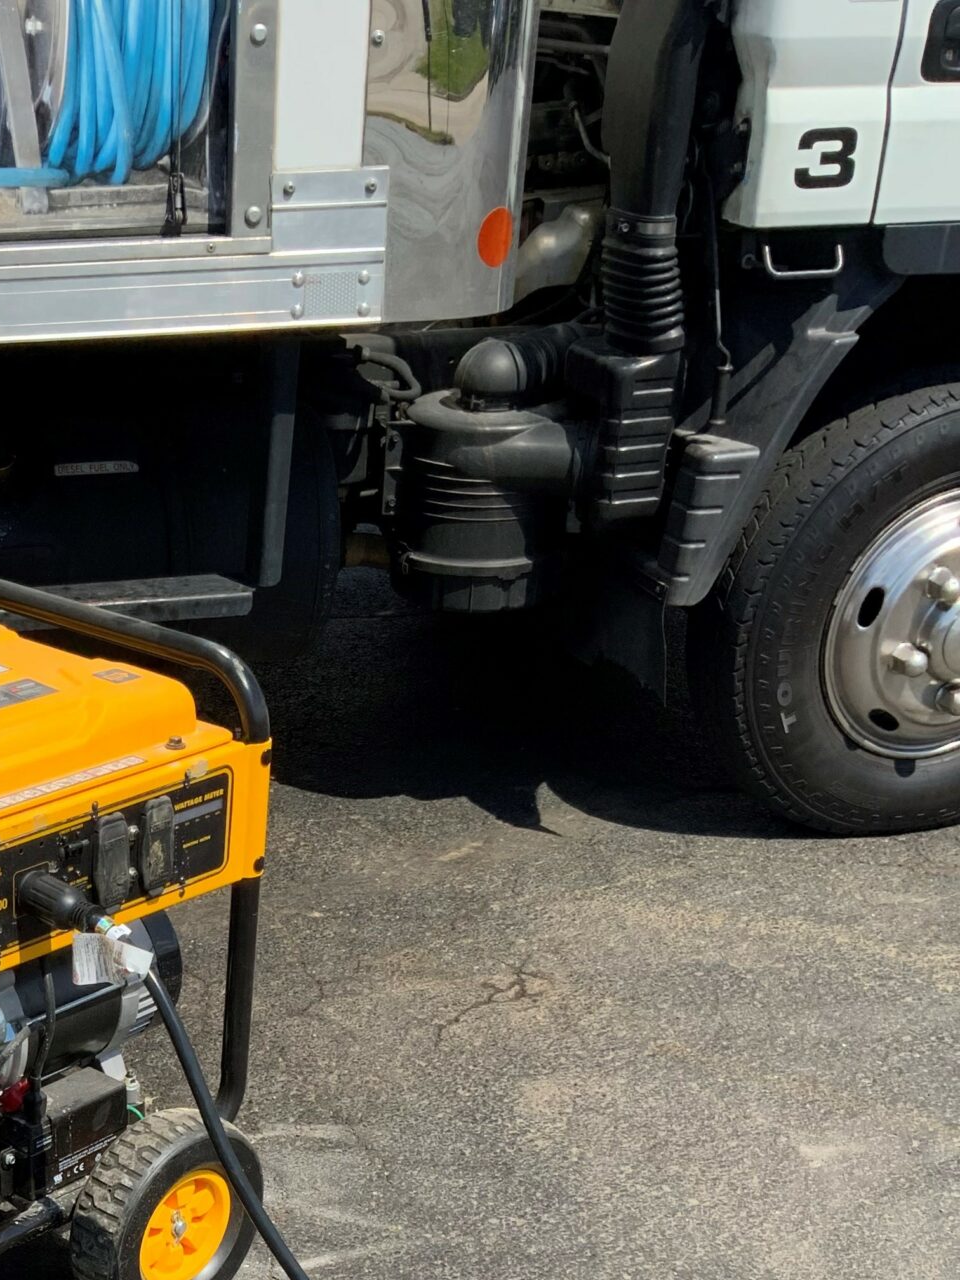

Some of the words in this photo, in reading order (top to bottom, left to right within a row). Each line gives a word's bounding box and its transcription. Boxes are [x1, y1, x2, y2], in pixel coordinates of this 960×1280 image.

[794, 126, 858, 189] 3
[58, 463, 85, 474] DIESEL
[89, 463, 109, 473] FUEL
[174, 795, 203, 811] WATTAGE
